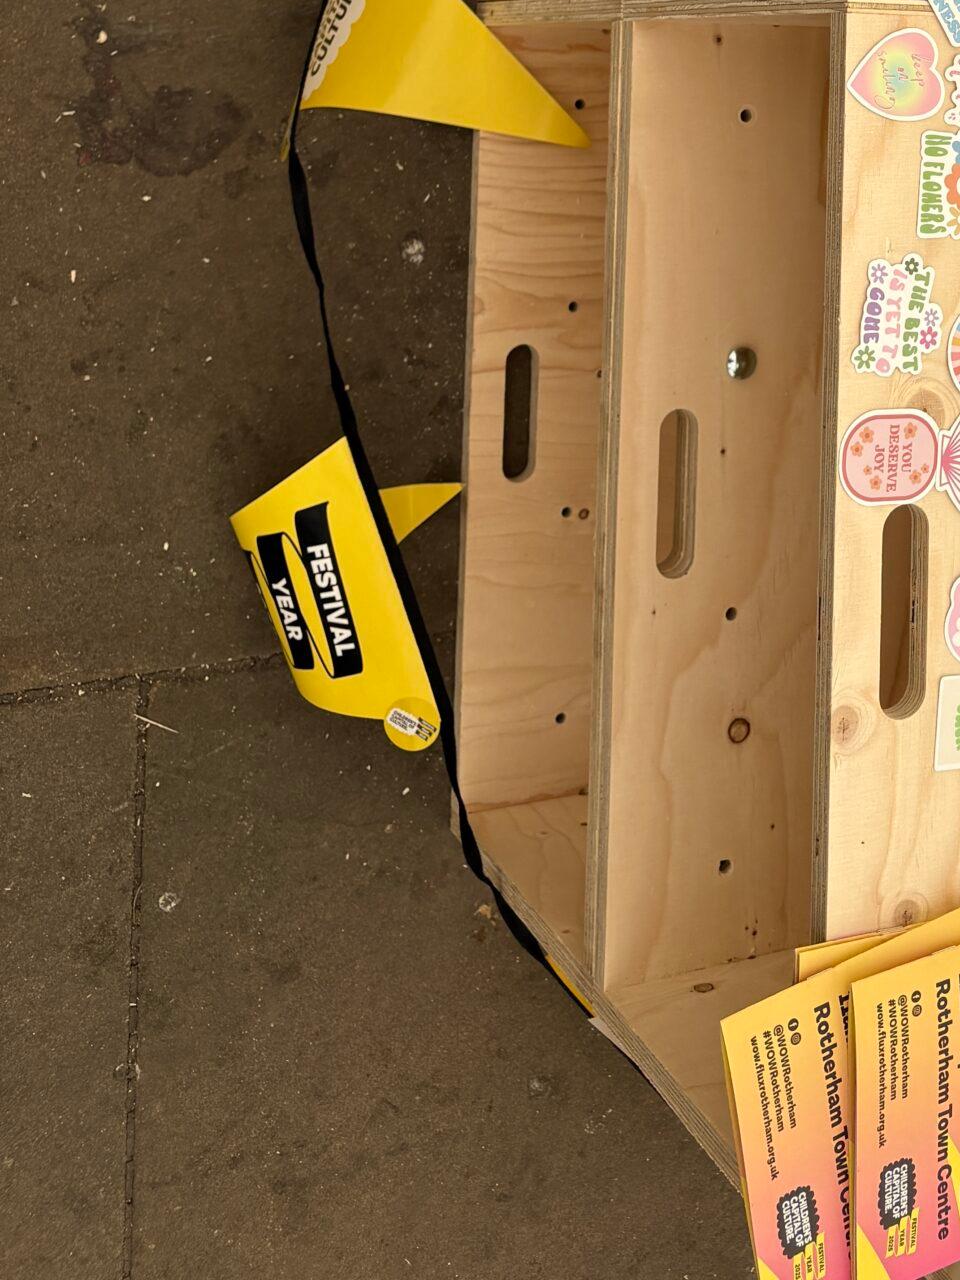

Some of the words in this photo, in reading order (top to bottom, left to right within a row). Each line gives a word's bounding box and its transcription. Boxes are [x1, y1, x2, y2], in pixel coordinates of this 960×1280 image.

[924, 134, 952, 157] NO
[919, 162, 946, 234] FLOWERS
[889, 269, 908, 291] IS
[909, 272, 931, 310] THE
[884, 297, 902, 338] YET
[902, 317, 920, 371] BEST
[876, 344, 898, 374] TO
[873, 444, 885, 472] JOY
[886, 424, 900, 492] DESERVE
[901, 443, 912, 472] YOU
[272, 577, 303, 640] YEAR
[306, 544, 355, 656] FESTIVAL
[888, 999, 897, 1101] #WOWRotherham
[898, 995, 909, 1099] @WOWRotherham
[936, 979, 952, 1104] Rotherham
[762, 1030, 785, 1132] #WOWRotherham
[773, 1025, 798, 1129] @WOWRotherham
[814, 1002, 842, 1128] Rotherham
[832, 1126, 849, 1183] Town
[876, 1003, 887, 1148] wow.fluxrotherham.org.uk
[750, 1036, 779, 1180] wow.fluxrotherham.org.uk
[937, 1104, 953, 1162] Town
[884, 1170, 892, 1214] CULTURE.
[892, 1167, 900, 1205] CAPITAL
[893, 1206, 900, 1219] OF
[900, 1164, 908, 1216] CHILDREN'S
[937, 1164, 952, 1242] Centre
[782, 1200, 794, 1244] CULTURE.
[790, 1196, 801, 1234] CAPITAL
[794, 1235, 804, 1247] OF
[798, 1192, 812, 1244] CHILDREN'S
